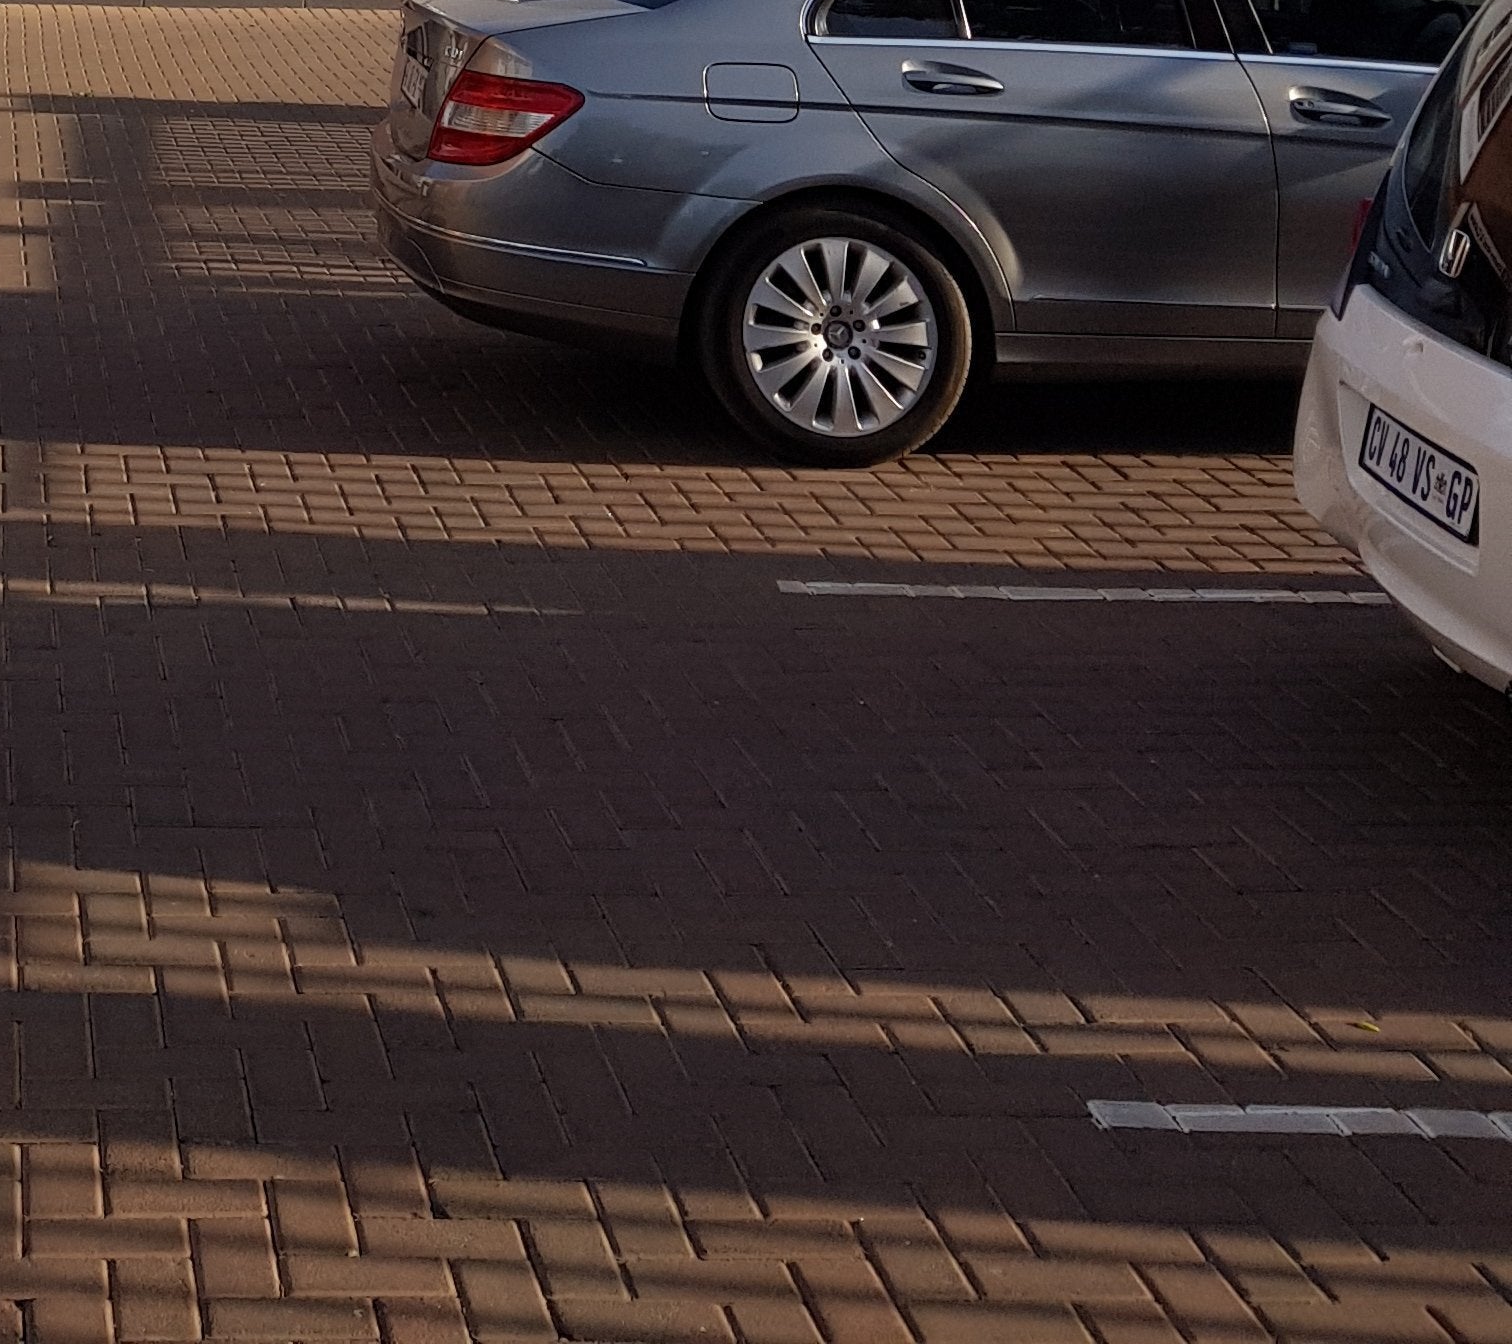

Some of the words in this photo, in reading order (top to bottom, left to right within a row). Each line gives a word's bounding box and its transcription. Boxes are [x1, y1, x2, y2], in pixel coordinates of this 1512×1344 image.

[1368, 415, 1390, 466] CV
[1388, 431, 1410, 484] 48
[1411, 446, 1436, 502] VS
[1445, 469, 1474, 526] GP
